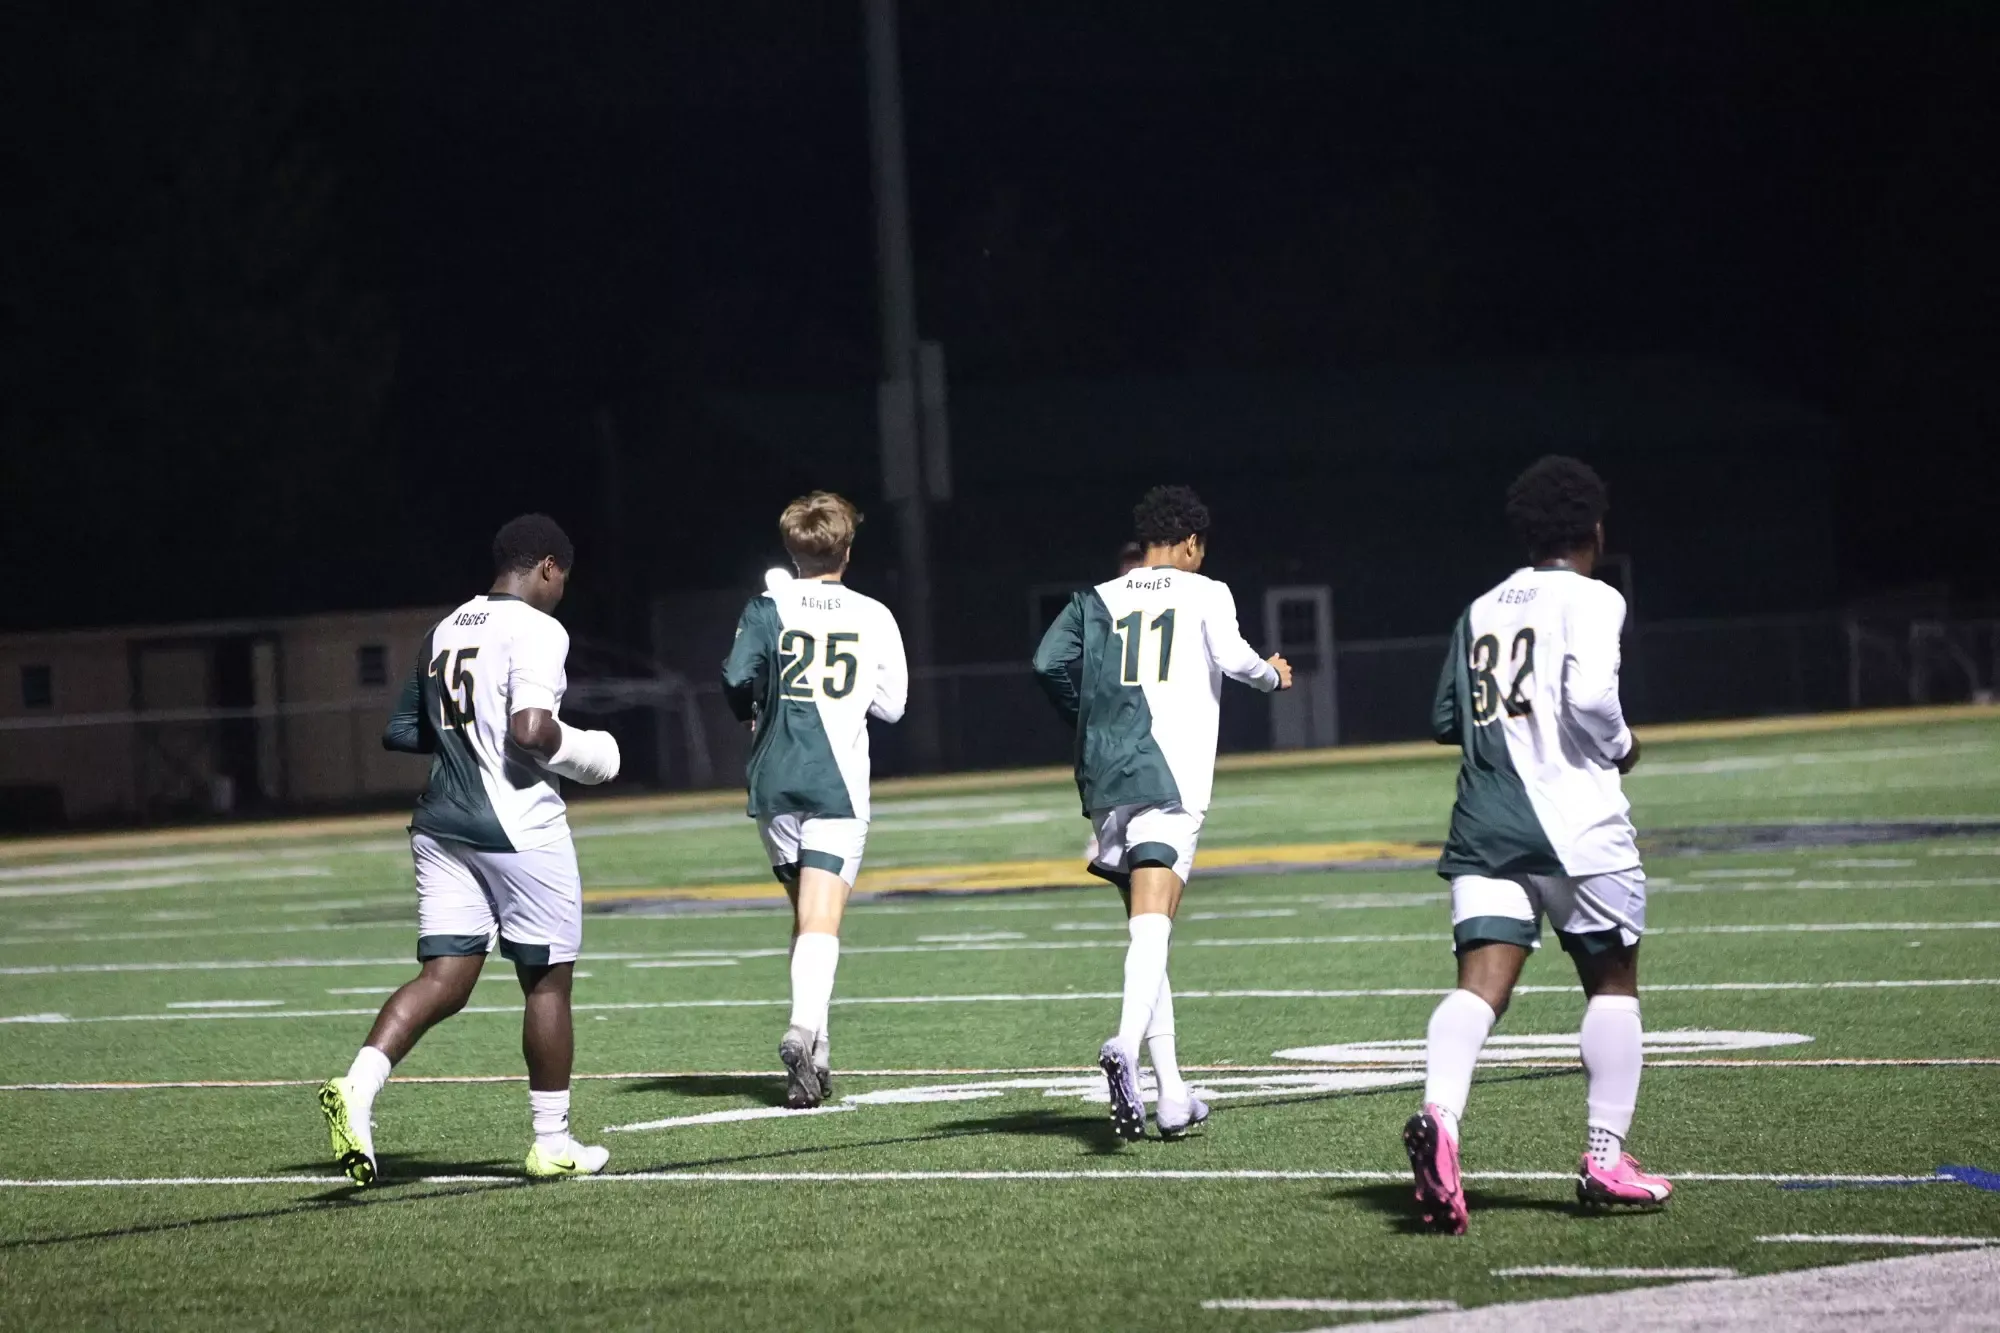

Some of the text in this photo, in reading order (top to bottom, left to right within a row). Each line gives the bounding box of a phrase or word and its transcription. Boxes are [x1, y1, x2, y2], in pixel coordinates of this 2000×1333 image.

[453, 612, 490, 626] AGGIES
[801, 596, 841, 610] AGGIES
[778, 629, 860, 702] 25
[1113, 607, 1176, 686] 11
[1469, 626, 1536, 727] 32
[428, 646, 480, 731] 15
